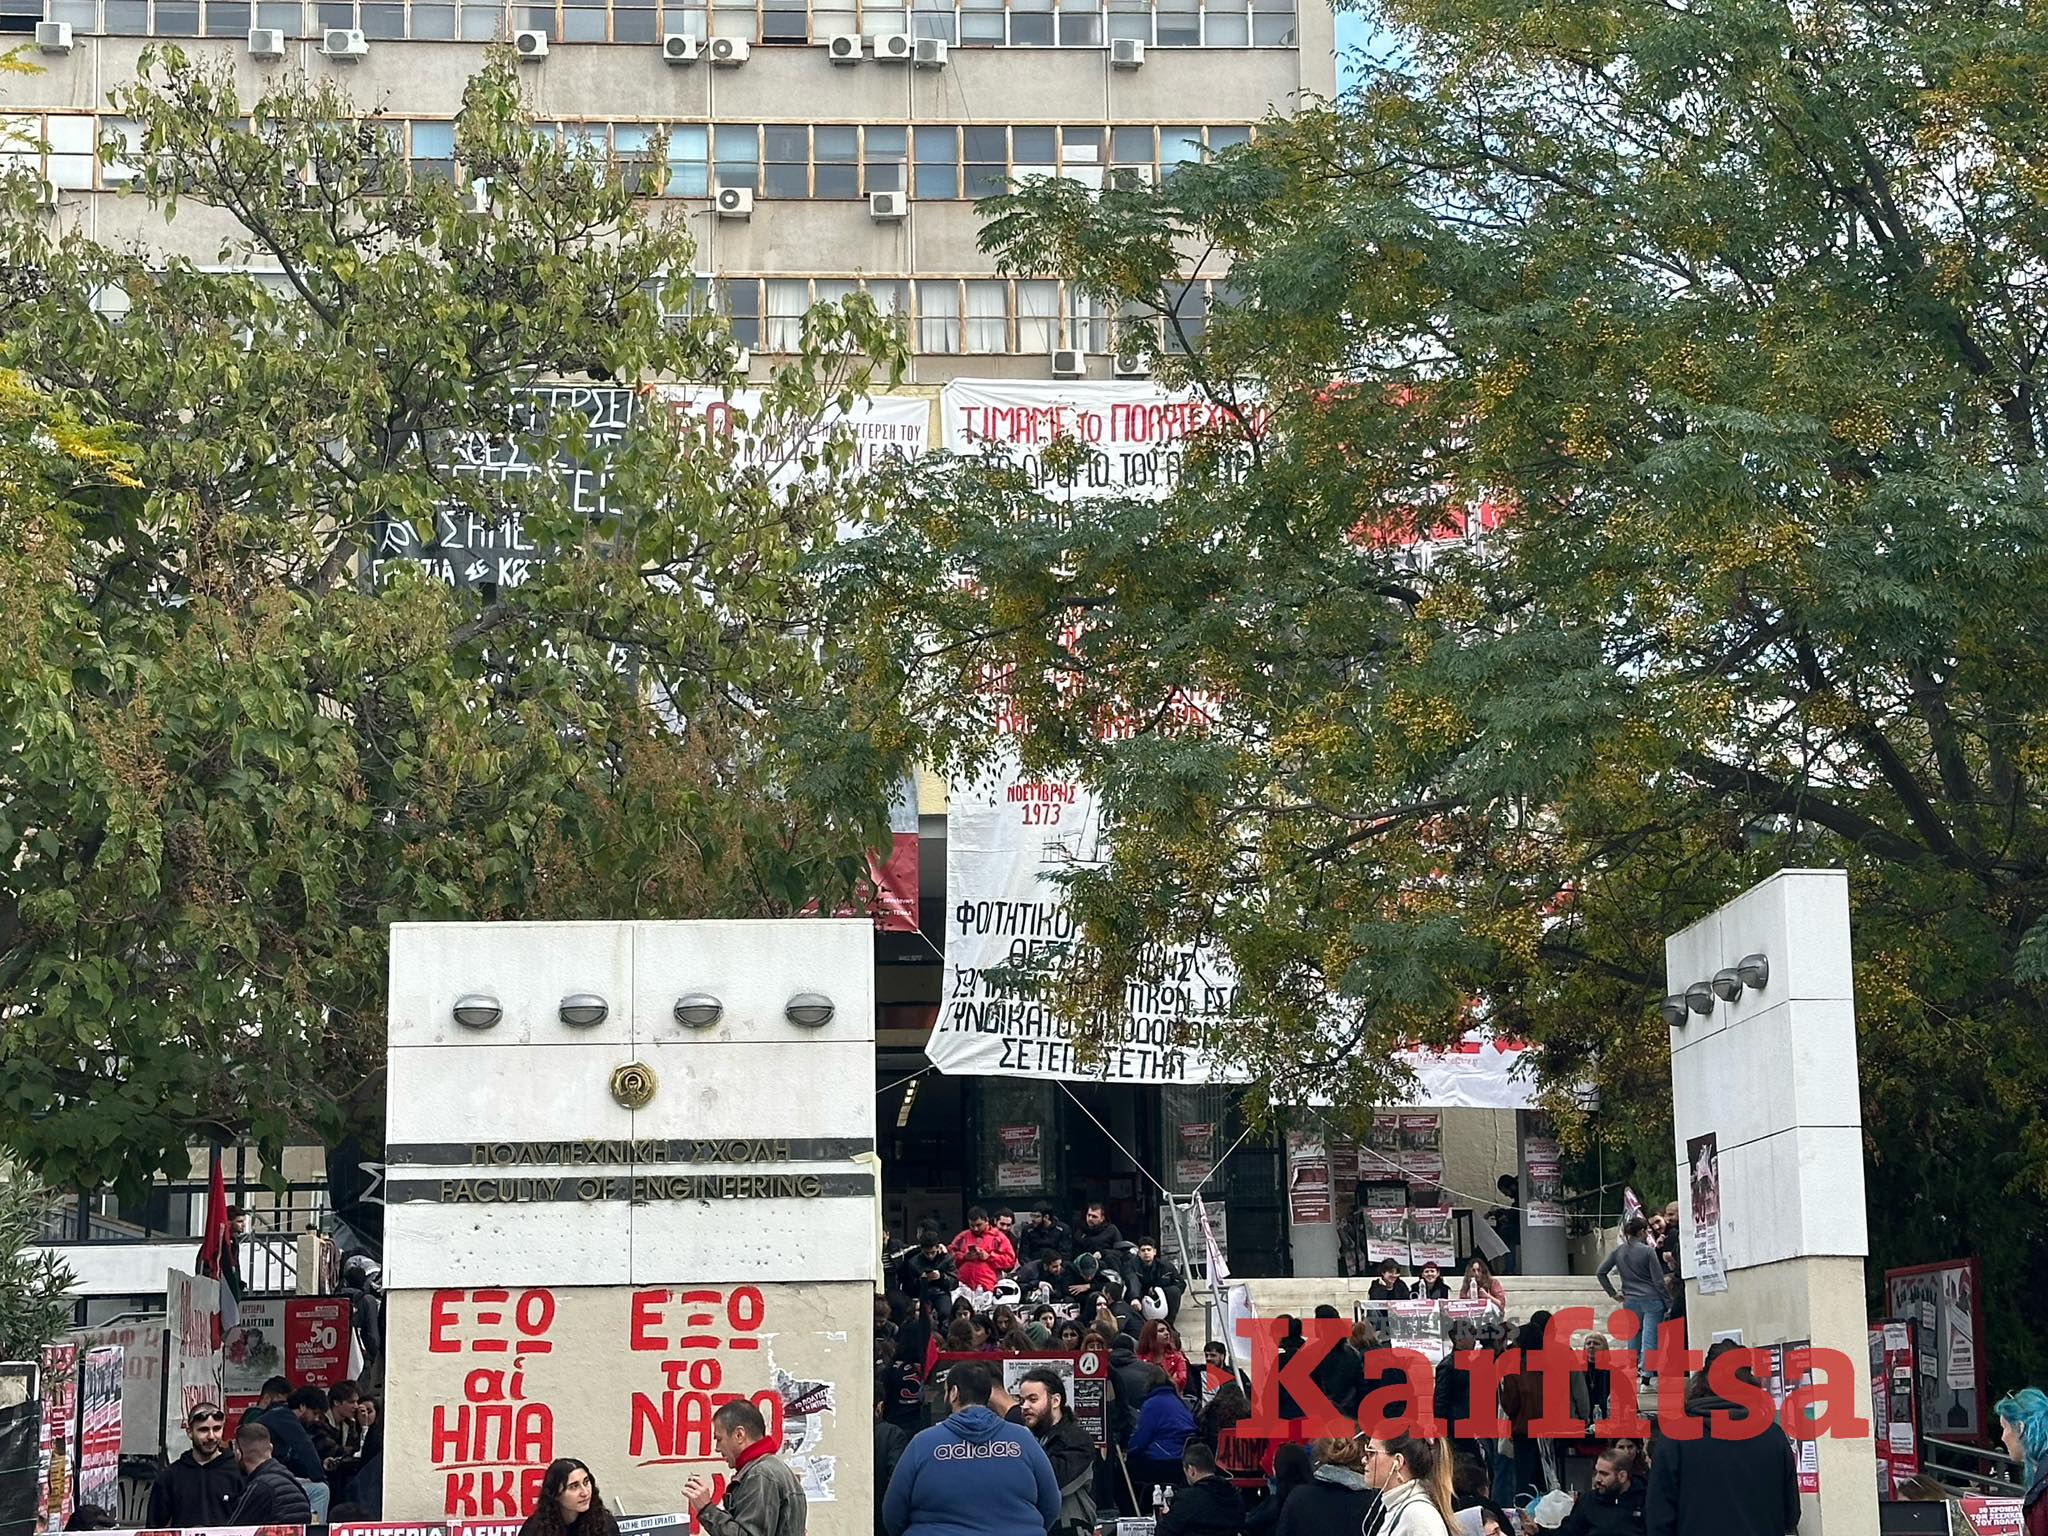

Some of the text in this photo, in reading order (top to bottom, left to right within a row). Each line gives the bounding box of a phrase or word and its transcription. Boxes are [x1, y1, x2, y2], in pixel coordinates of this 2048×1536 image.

[901, 423, 921, 442] ΤΟΥ
[1120, 452, 1158, 487] ΤΟΥ
[1021, 803, 1061, 825] 1973
[472, 1138, 791, 1167] ΠΟΛΥΤΕΧΝΙΚΗ ΣΧΟΛΗ
[440, 1174, 822, 1203] FACULTY OF ENGINEERING
[310, 1321, 337, 1350] 50
[431, 1403, 555, 1464] ΗΠΑ
[934, 1440, 1021, 1461] adidas
